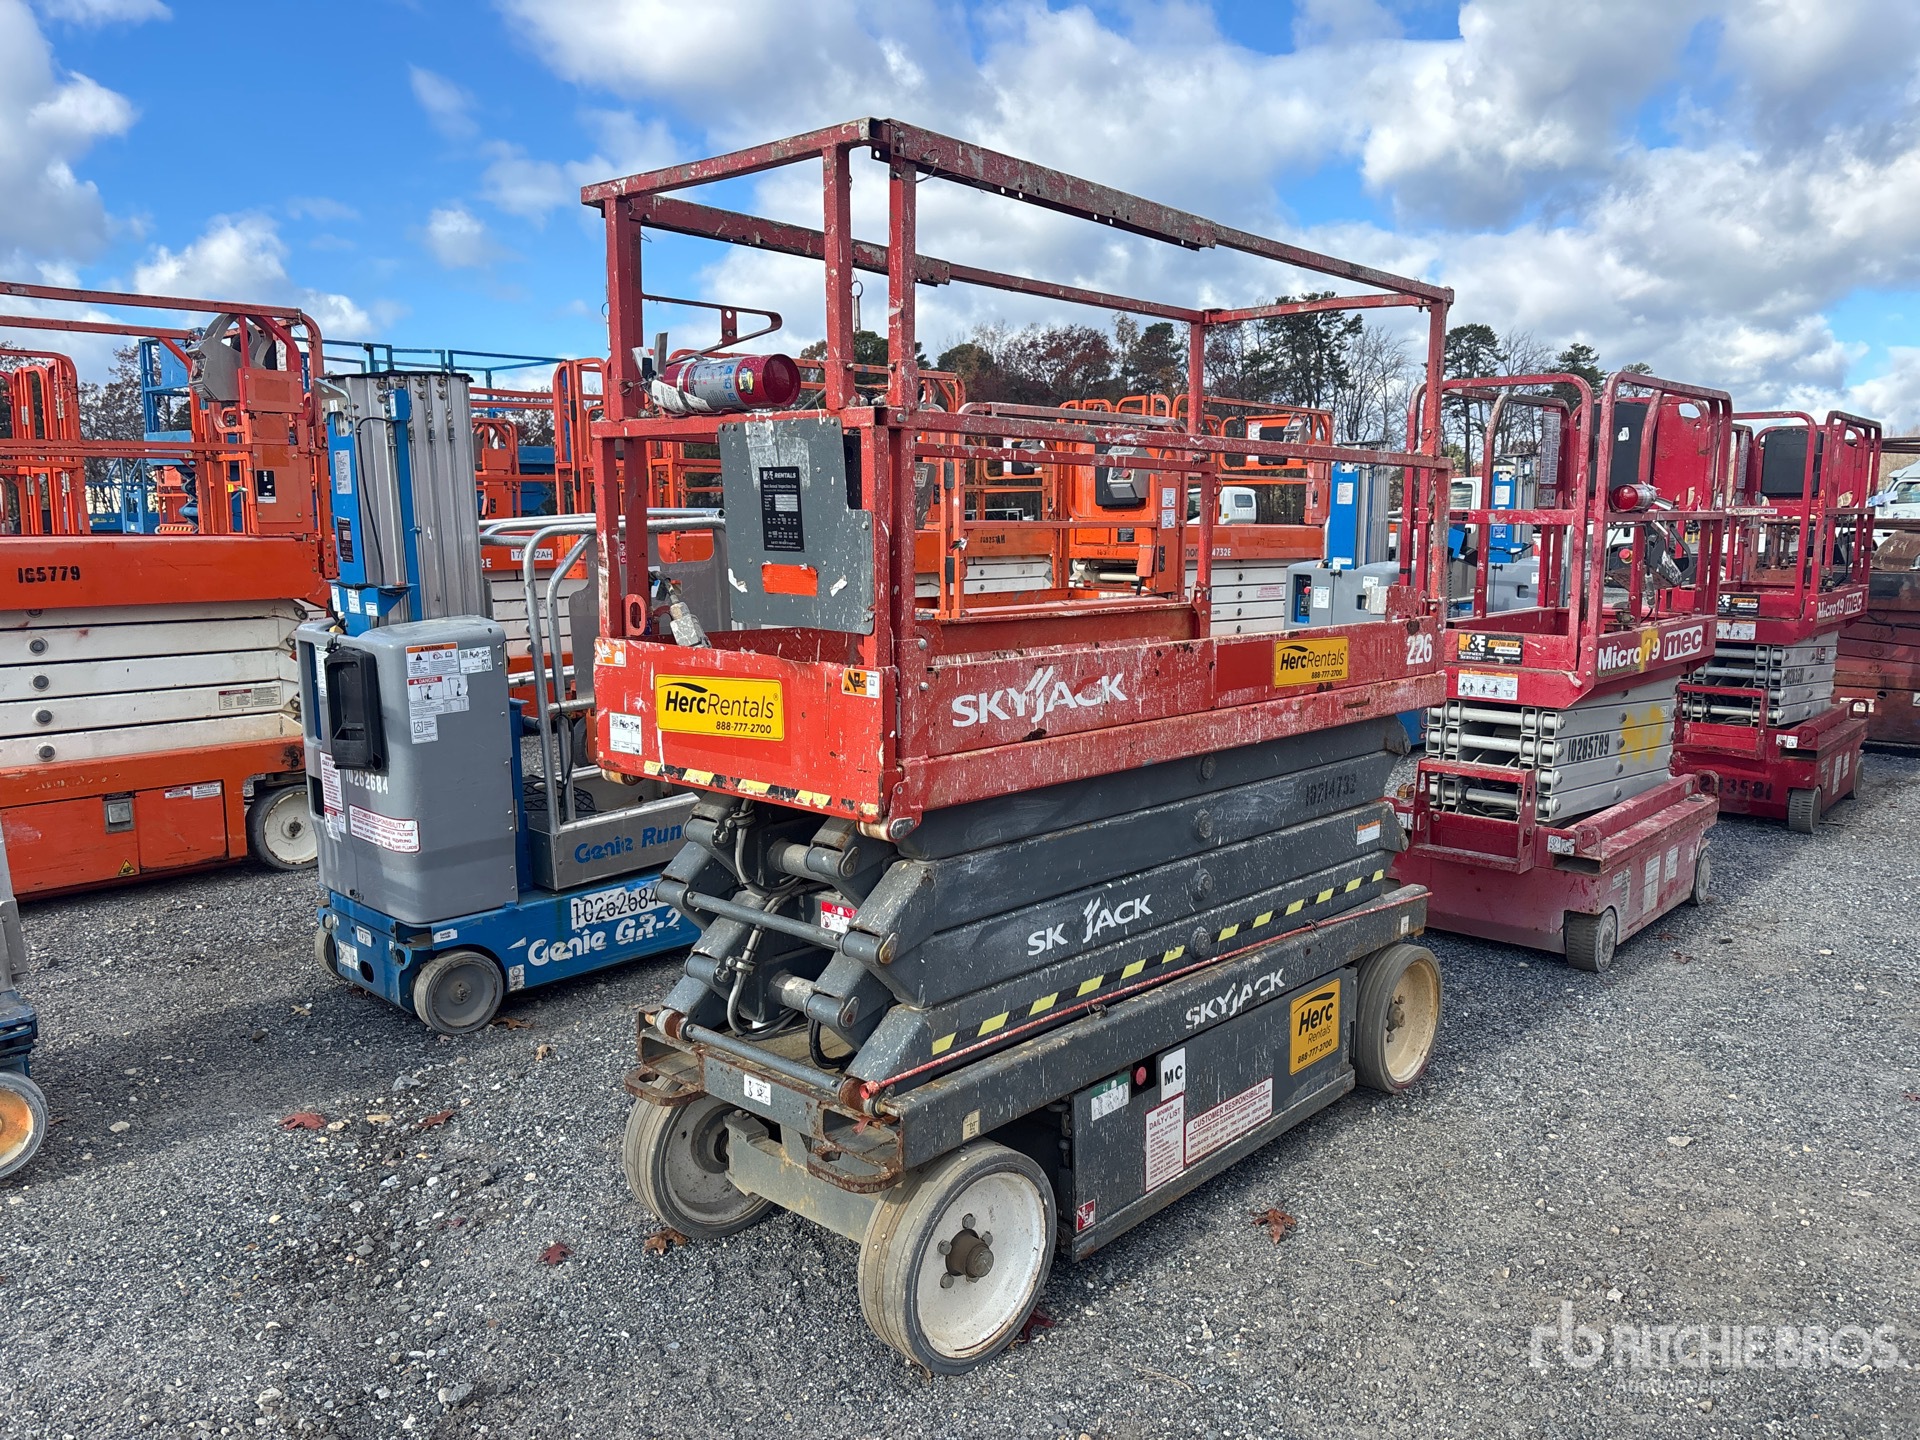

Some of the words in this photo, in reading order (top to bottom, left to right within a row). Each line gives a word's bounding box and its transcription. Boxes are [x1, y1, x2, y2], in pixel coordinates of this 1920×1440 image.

[18, 566, 80, 584] 165779
[1406, 633, 1432, 665] 226
[1458, 634, 1486, 652] H&E
[1664, 628, 1702, 658] mec
[1311, 669, 1342, 679] 888-777-2700
[952, 665, 1127, 728] SKYJACK
[716, 720, 772, 734] 888-777-2700
[1306, 774, 1356, 806] 10214732
[352, 808, 371, 821] CUSTOMER
[371, 814, 406, 829] RESPONSIBILITY
[641, 824, 682, 848] Run
[528, 929, 607, 966] Genie
[1186, 968, 1285, 1030] SKYJACK
[1298, 1002, 1334, 1036] Herc
[1308, 1024, 1330, 1044] Rentals
[1297, 1038, 1332, 1064] 888-777-2700
[1164, 1064, 1183, 1086] MC
[1156, 1103, 1173, 1117] MINIMUM
[1193, 1105, 1223, 1129] CUSTOMER
[1224, 1082, 1265, 1112] RESPONSIBILITY
[1149, 1115, 1164, 1130] DAILY
[1169, 1106, 1180, 1119] LIST
